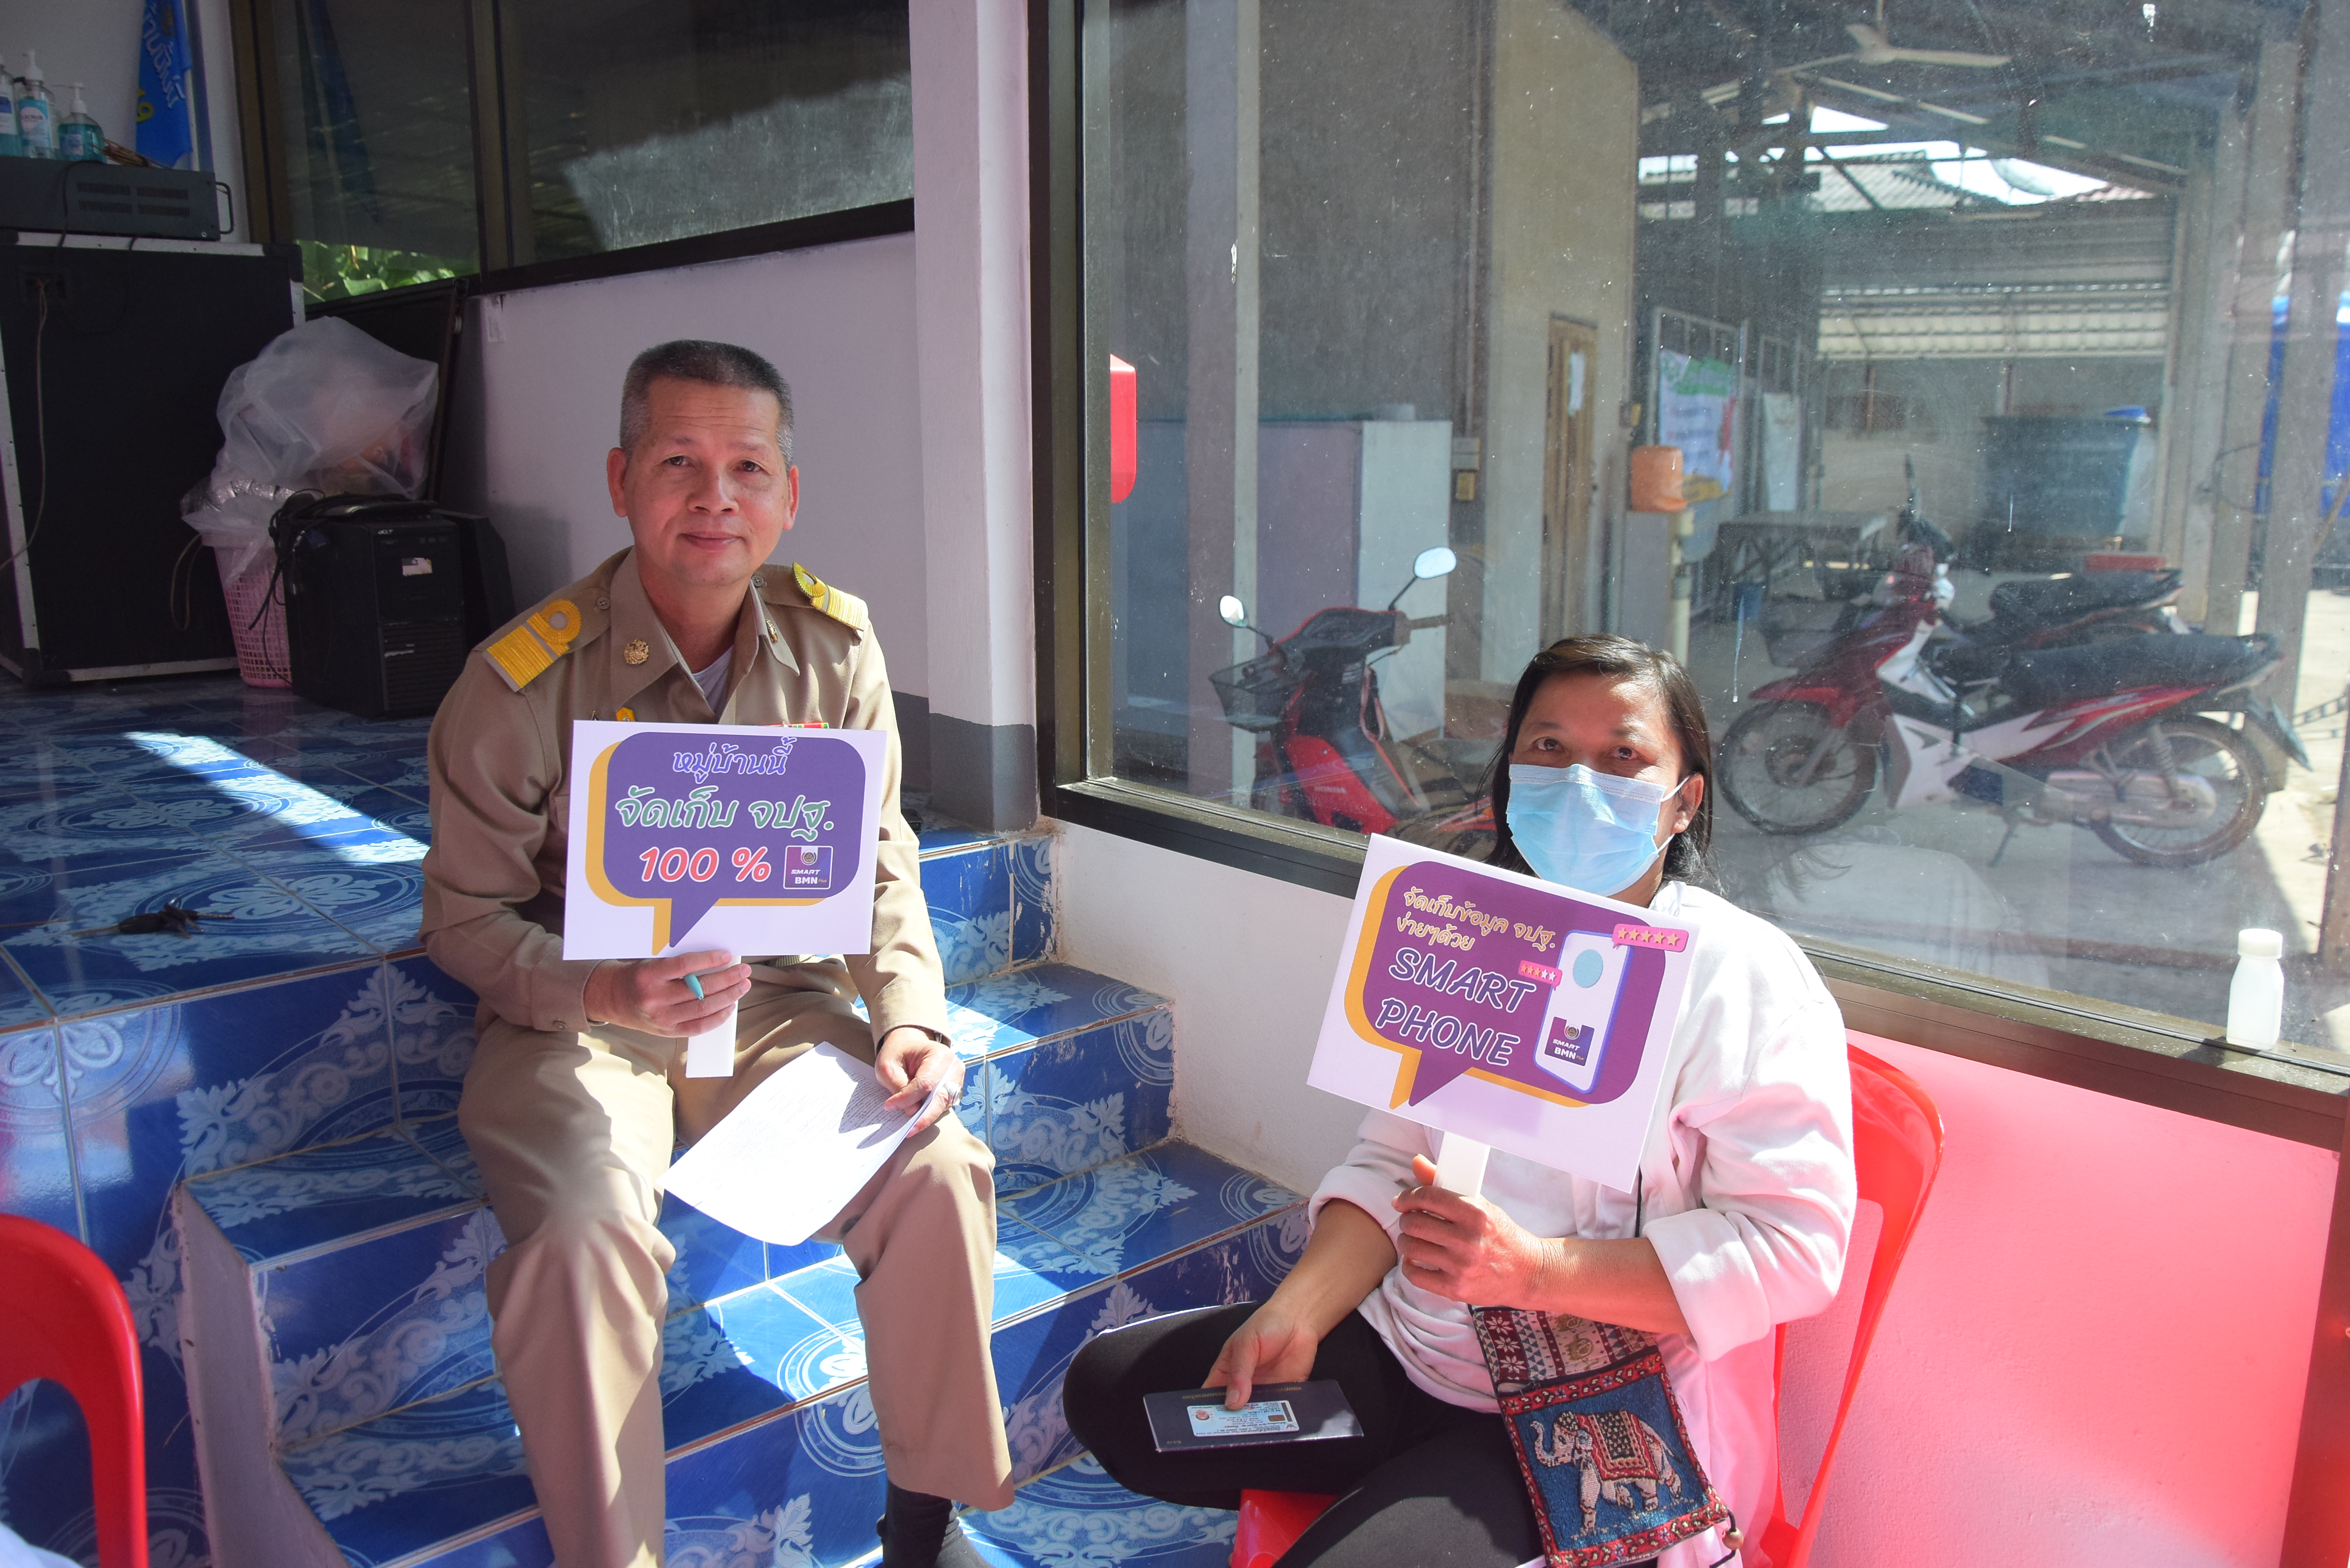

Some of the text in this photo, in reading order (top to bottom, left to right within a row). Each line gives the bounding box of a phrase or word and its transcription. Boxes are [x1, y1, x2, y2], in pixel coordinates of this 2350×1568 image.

[673, 736, 797, 783] หมู่บ้านนี้
[615, 785, 834, 841] จัดเก็บ จปฐ.
[640, 846, 771, 883] 100 %
[1397, 912, 1476, 951] ง่ายๆด้วย
[1403, 886, 1556, 952] จัดเก็บข้อมูล จปฐ.
[1389, 947, 1537, 1013] SMART
[1375, 997, 1520, 1066] PHONE
[1552, 1039, 1581, 1051] SMART
[1554, 1047, 1576, 1059] BMN
